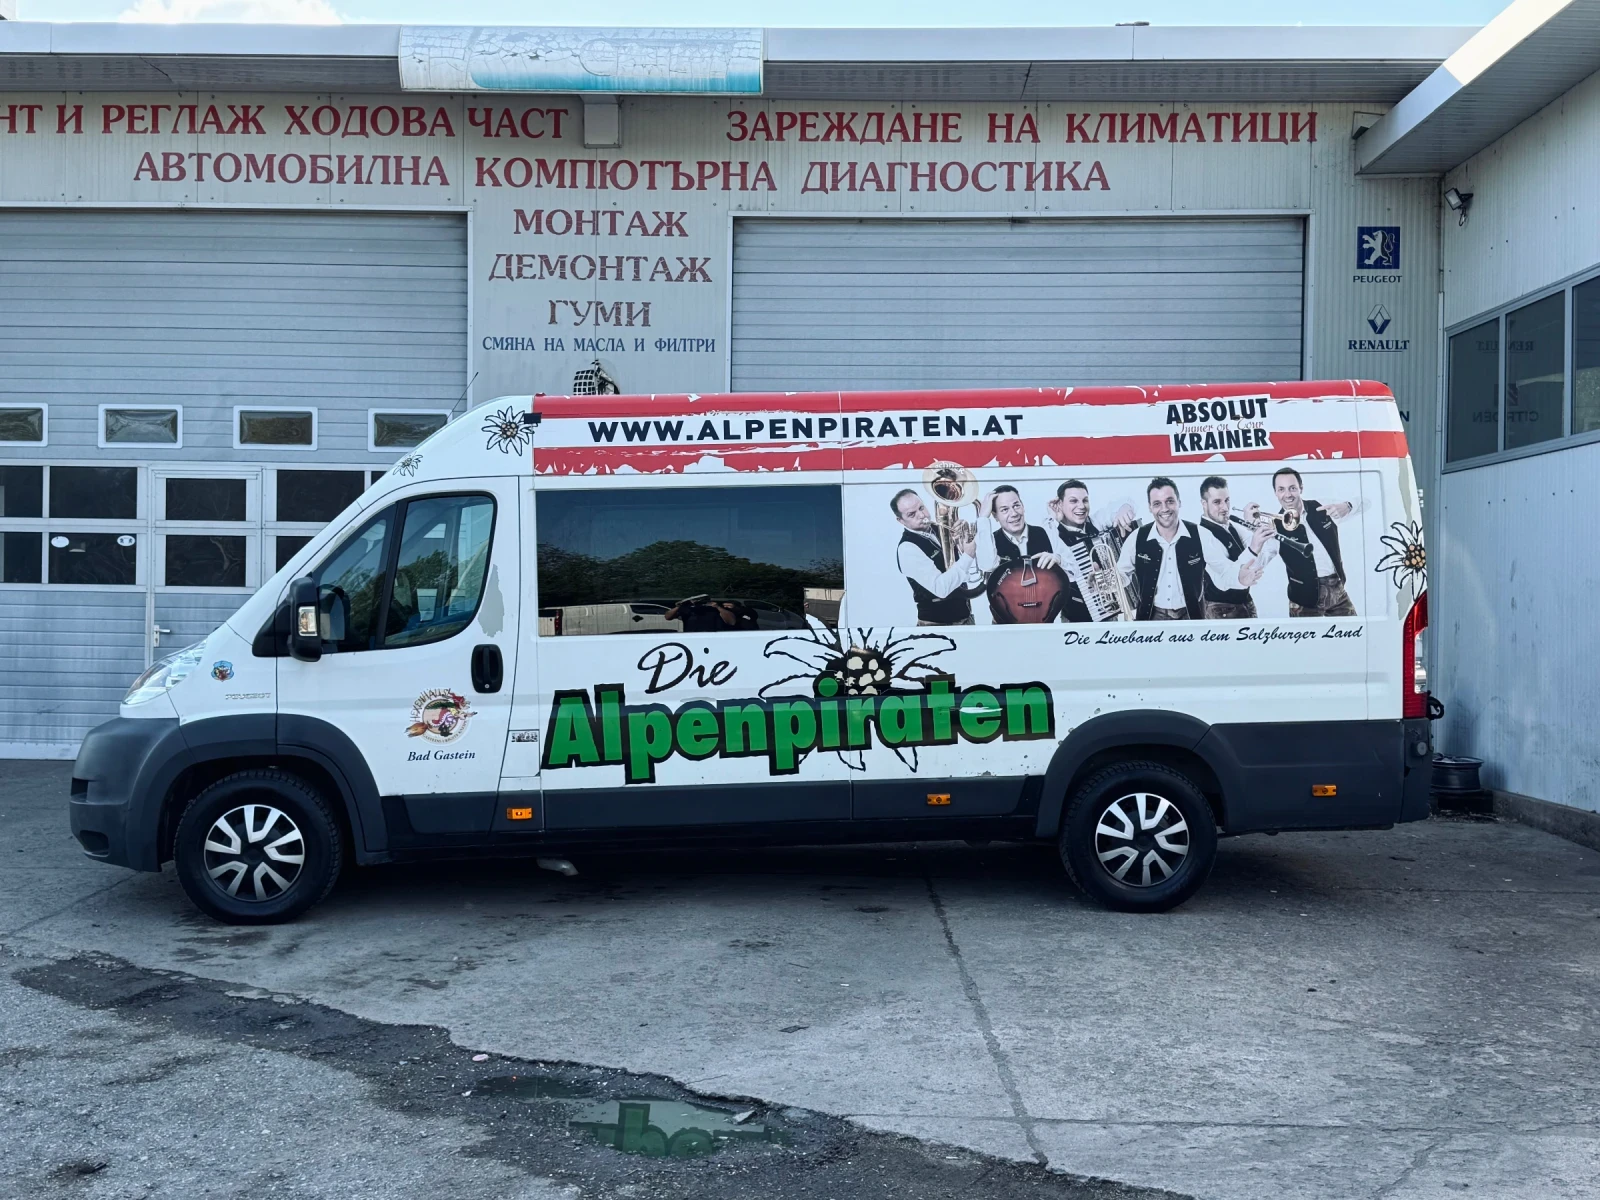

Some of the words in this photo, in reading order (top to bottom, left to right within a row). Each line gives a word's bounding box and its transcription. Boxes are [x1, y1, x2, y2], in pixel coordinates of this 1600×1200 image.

[56, 105, 84, 134] И
[102, 105, 266, 135] РЕГЛАЖ
[285, 106, 456, 138] ХОДОВА
[467, 108, 569, 139] ЧАСТ
[726, 111, 963, 145] ЗАРЕЖДАНЕ
[987, 113, 1041, 144] НА
[1066, 112, 1318, 145] КЛИМАТИЦИ
[134, 152, 450, 187] АВТОМОБИЛНА
[475, 157, 778, 191] КОМПЮТЪРНА
[801, 161, 1111, 194] ДИАГНОСТИКА
[513, 208, 689, 237] МОНТАЖ
[488, 253, 713, 283] ДЕМОНТАЖ
[1353, 275, 1402, 284] PEUGEOT
[548, 299, 652, 327] ГУМИ
[482, 336, 536, 351] СМЯНА
[544, 337, 565, 352] НА
[573, 337, 626, 352] МАСЛА
[634, 338, 645, 352] И
[654, 337, 716, 353] ФИЛТРИ
[1348, 340, 1410, 350] RENAULT
[1166, 398, 1268, 425] ABSOLUT
[588, 414, 1024, 443] WWW.ALPENPIRATEN.AT
[1173, 428, 1268, 453] KRAINER
[1063, 631, 1090, 645] Die
[1096, 630, 1164, 645] Liveband
[1168, 633, 1195, 643] aus
[1200, 630, 1230, 642] dem
[1236, 626, 1316, 645] Salzburger
[1322, 625, 1364, 639] Land
[637, 642, 738, 695] Die
[541, 670, 1057, 785] Alpenpiraten
[407, 750, 431, 761] Bad
[433, 749, 476, 761] Gastein
